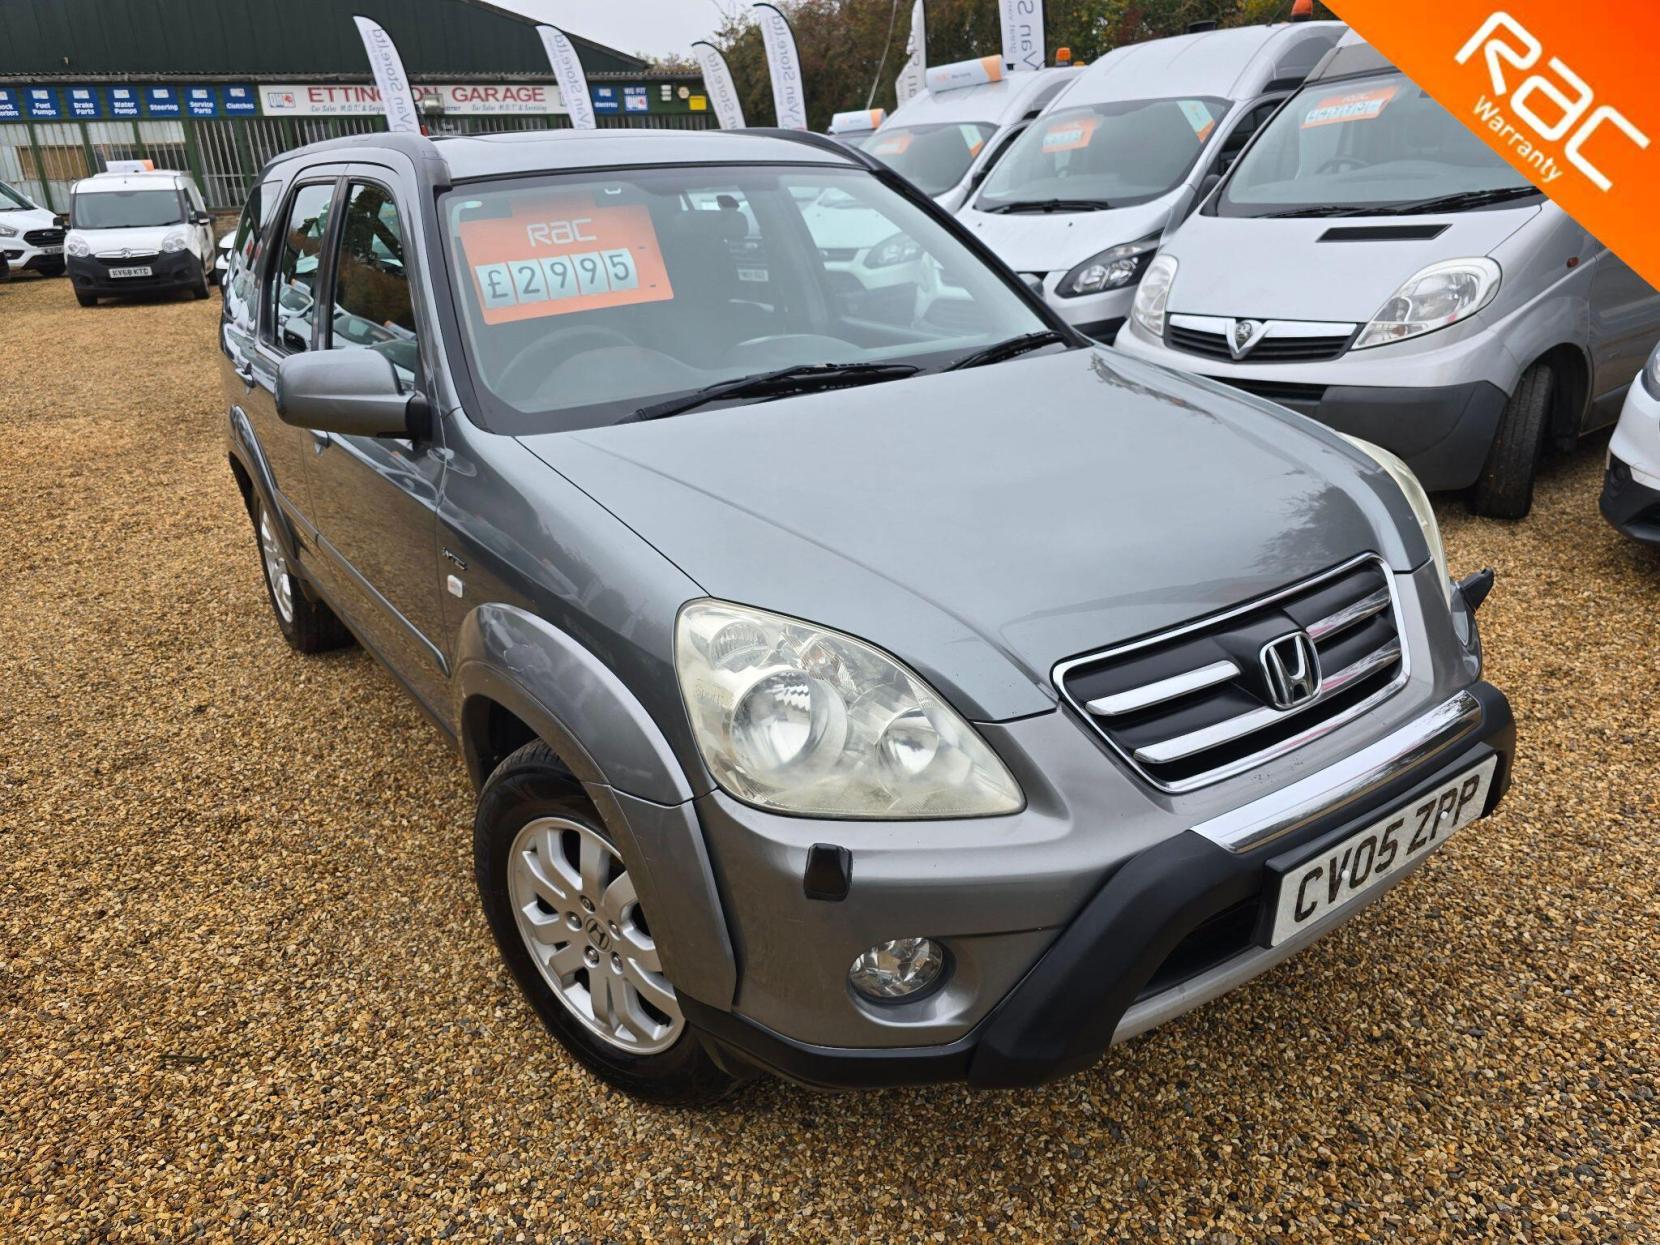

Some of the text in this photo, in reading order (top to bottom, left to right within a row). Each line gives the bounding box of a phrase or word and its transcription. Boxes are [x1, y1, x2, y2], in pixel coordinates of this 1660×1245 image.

[452, 86, 546, 102] GARAGE
[486, 251, 631, 300] £2995
[1406, 773, 1481, 856] ZPP
